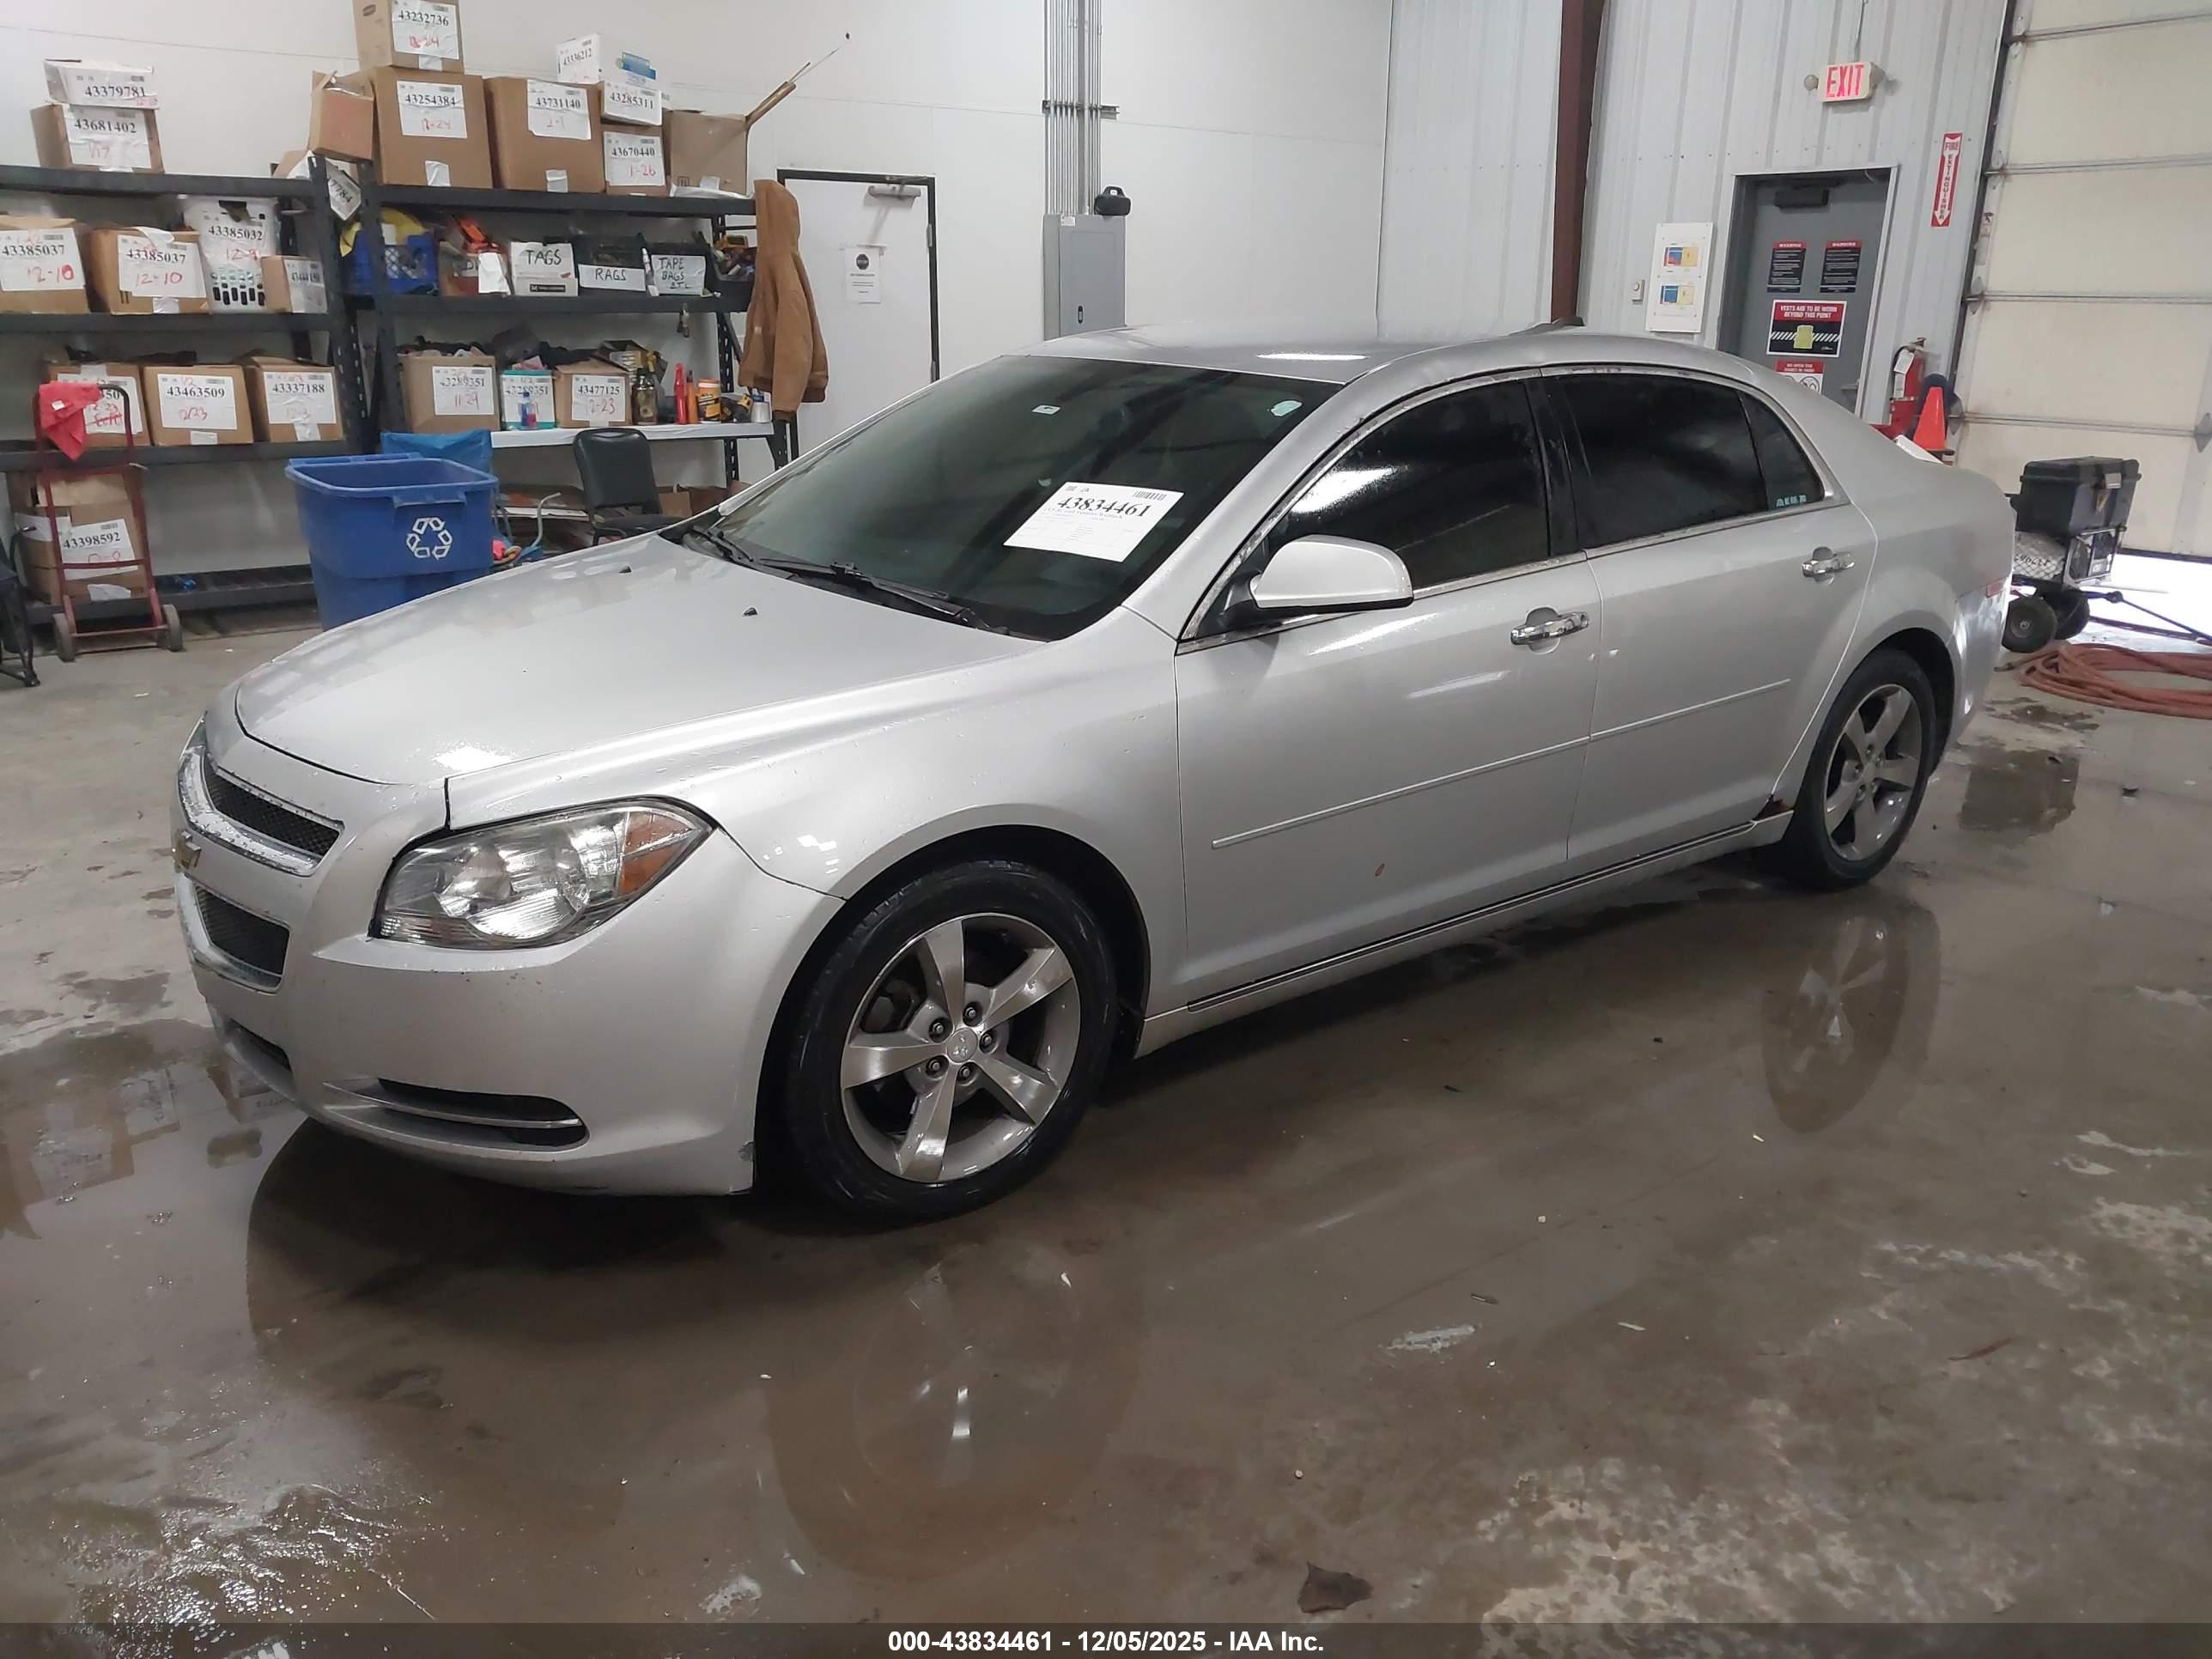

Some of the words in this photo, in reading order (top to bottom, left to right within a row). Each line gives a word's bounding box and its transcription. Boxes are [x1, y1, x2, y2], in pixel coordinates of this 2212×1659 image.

[398, 10, 449, 26] 43232736
[1826, 64, 1864, 98] EXIT
[85, 86, 145, 97] 43379781
[404, 94, 456, 106] 43254384
[536, 97, 581, 109] 43731140
[610, 92, 653, 110] 43285311
[74, 118, 137, 133] 43681402
[611, 147, 655, 158] 43670440
[1944, 142, 1959, 151] FIRE
[209, 225, 264, 241] 43385032
[2, 244, 64, 256] 43385037
[126, 248, 186, 265] 43385037
[526, 249, 562, 266] TAGS
[659, 258, 684, 270] TAPE
[595, 267, 627, 282] RAGS
[661, 270, 684, 282] BAGS
[167, 386, 225, 398] 43463509
[272, 383, 325, 394] 43337188
[578, 385, 620, 395] 43477125
[1058, 496, 1152, 517] 43834461
[64, 532, 121, 549] 43398592
